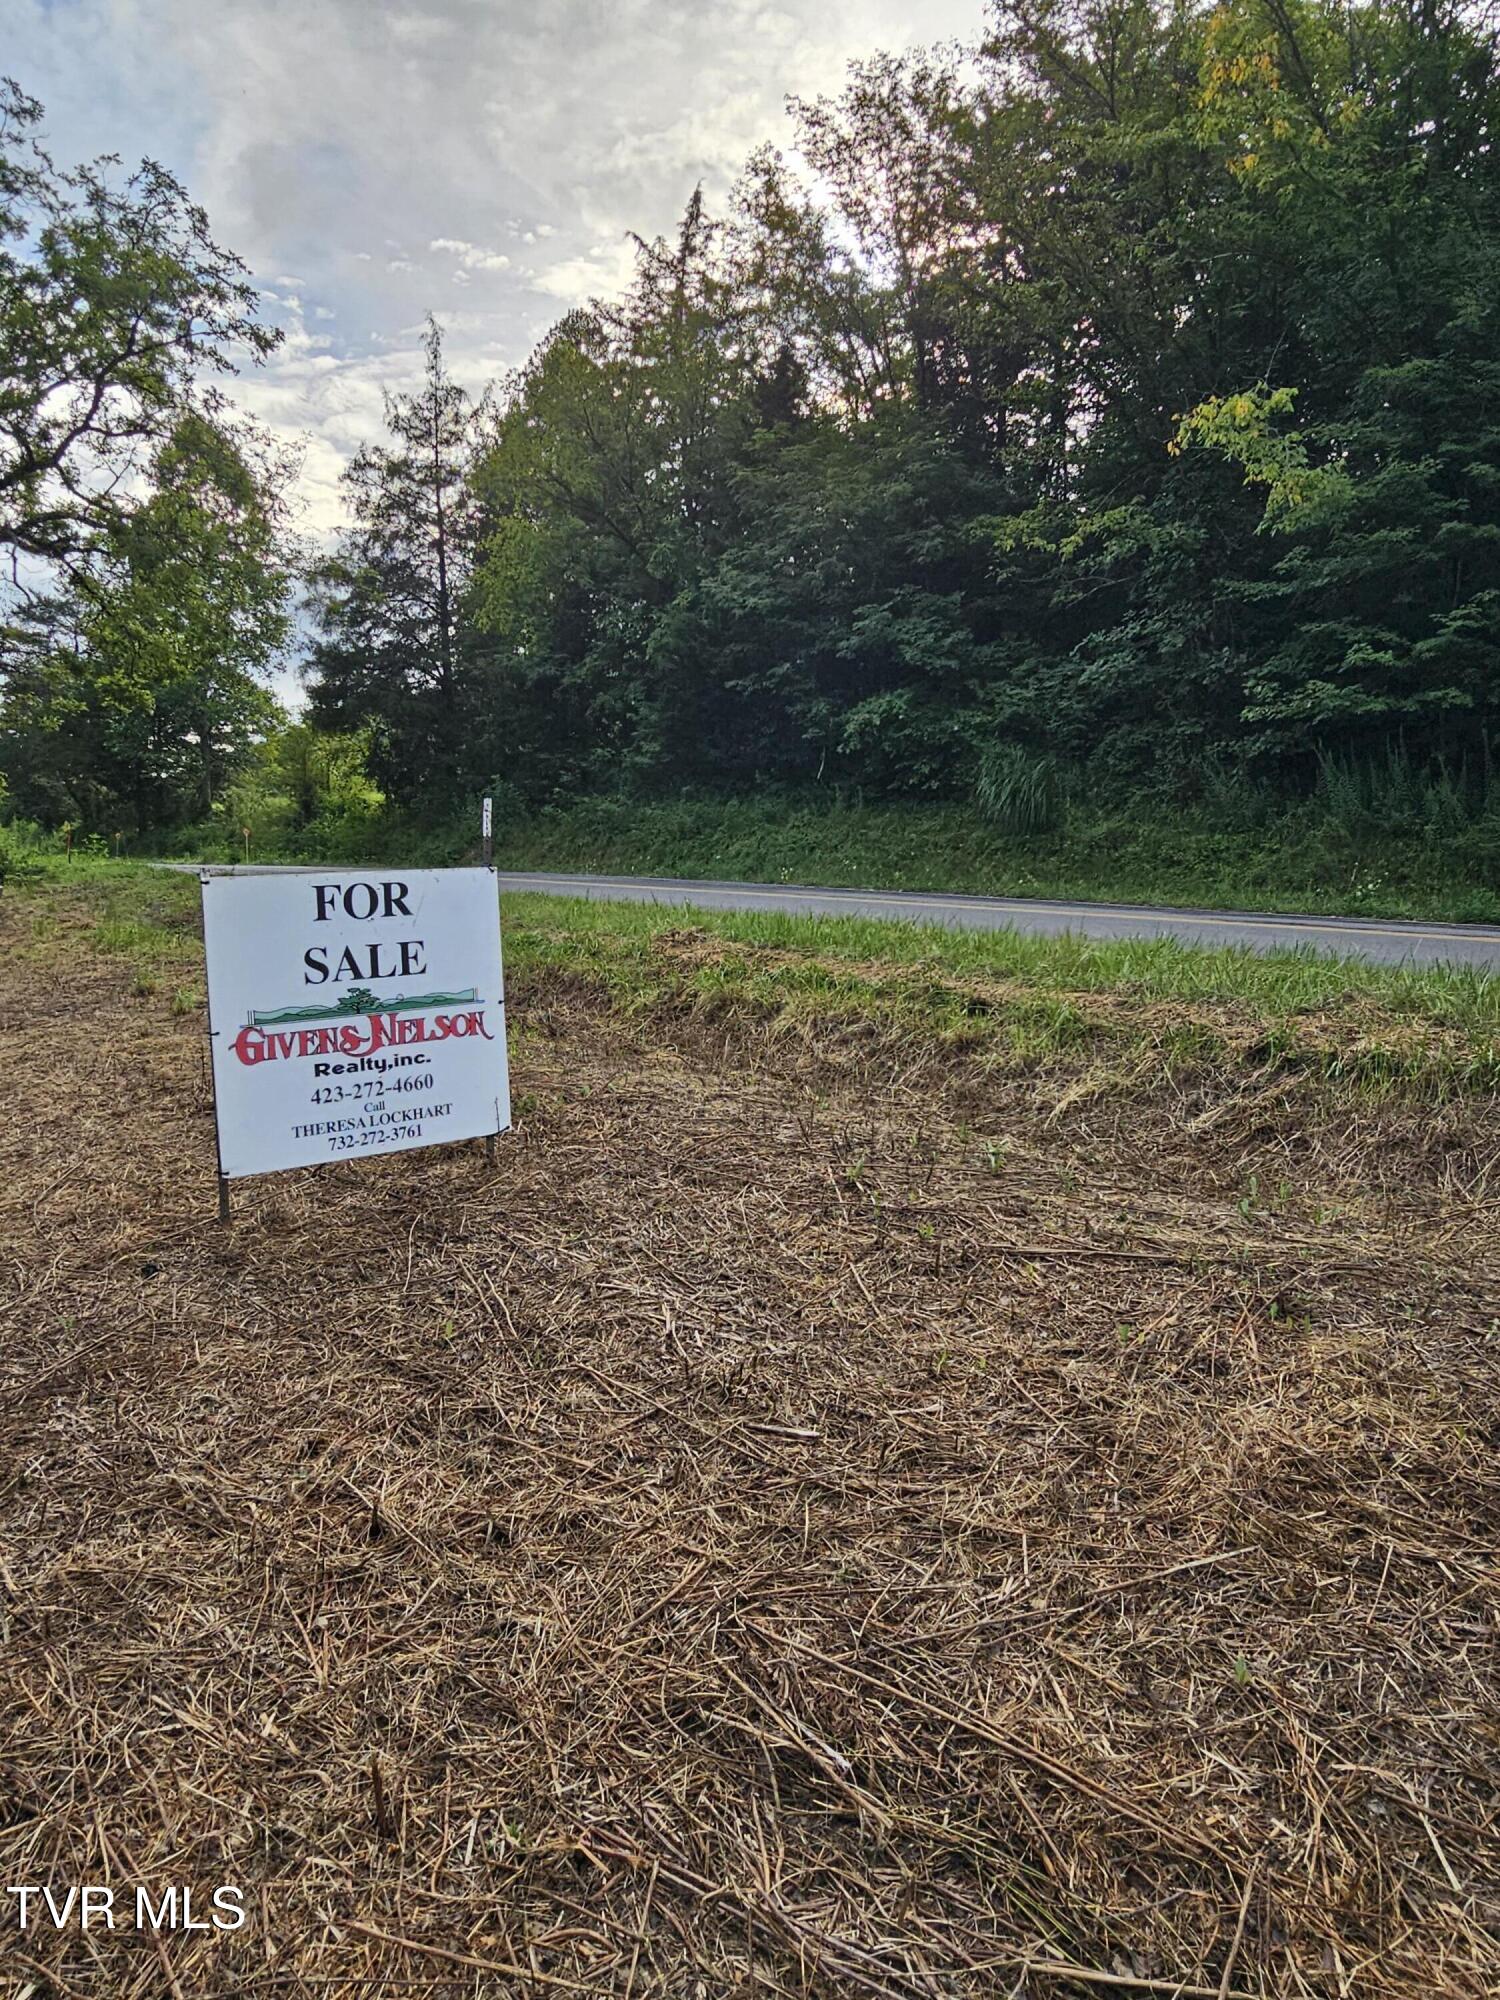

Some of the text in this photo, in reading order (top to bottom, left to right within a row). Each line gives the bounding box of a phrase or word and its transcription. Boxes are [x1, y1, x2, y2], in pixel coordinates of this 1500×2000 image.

[312, 882, 414, 921] FOR
[304, 941, 427, 985] SALE
[344, 1011, 495, 1058] NELSON
[310, 1073, 434, 1105] 423-272-4660
[364, 1100, 386, 1113] Call
[291, 1103, 453, 1139] THERESA LOCKHART
[328, 1124, 423, 1151] 732-272-3761
